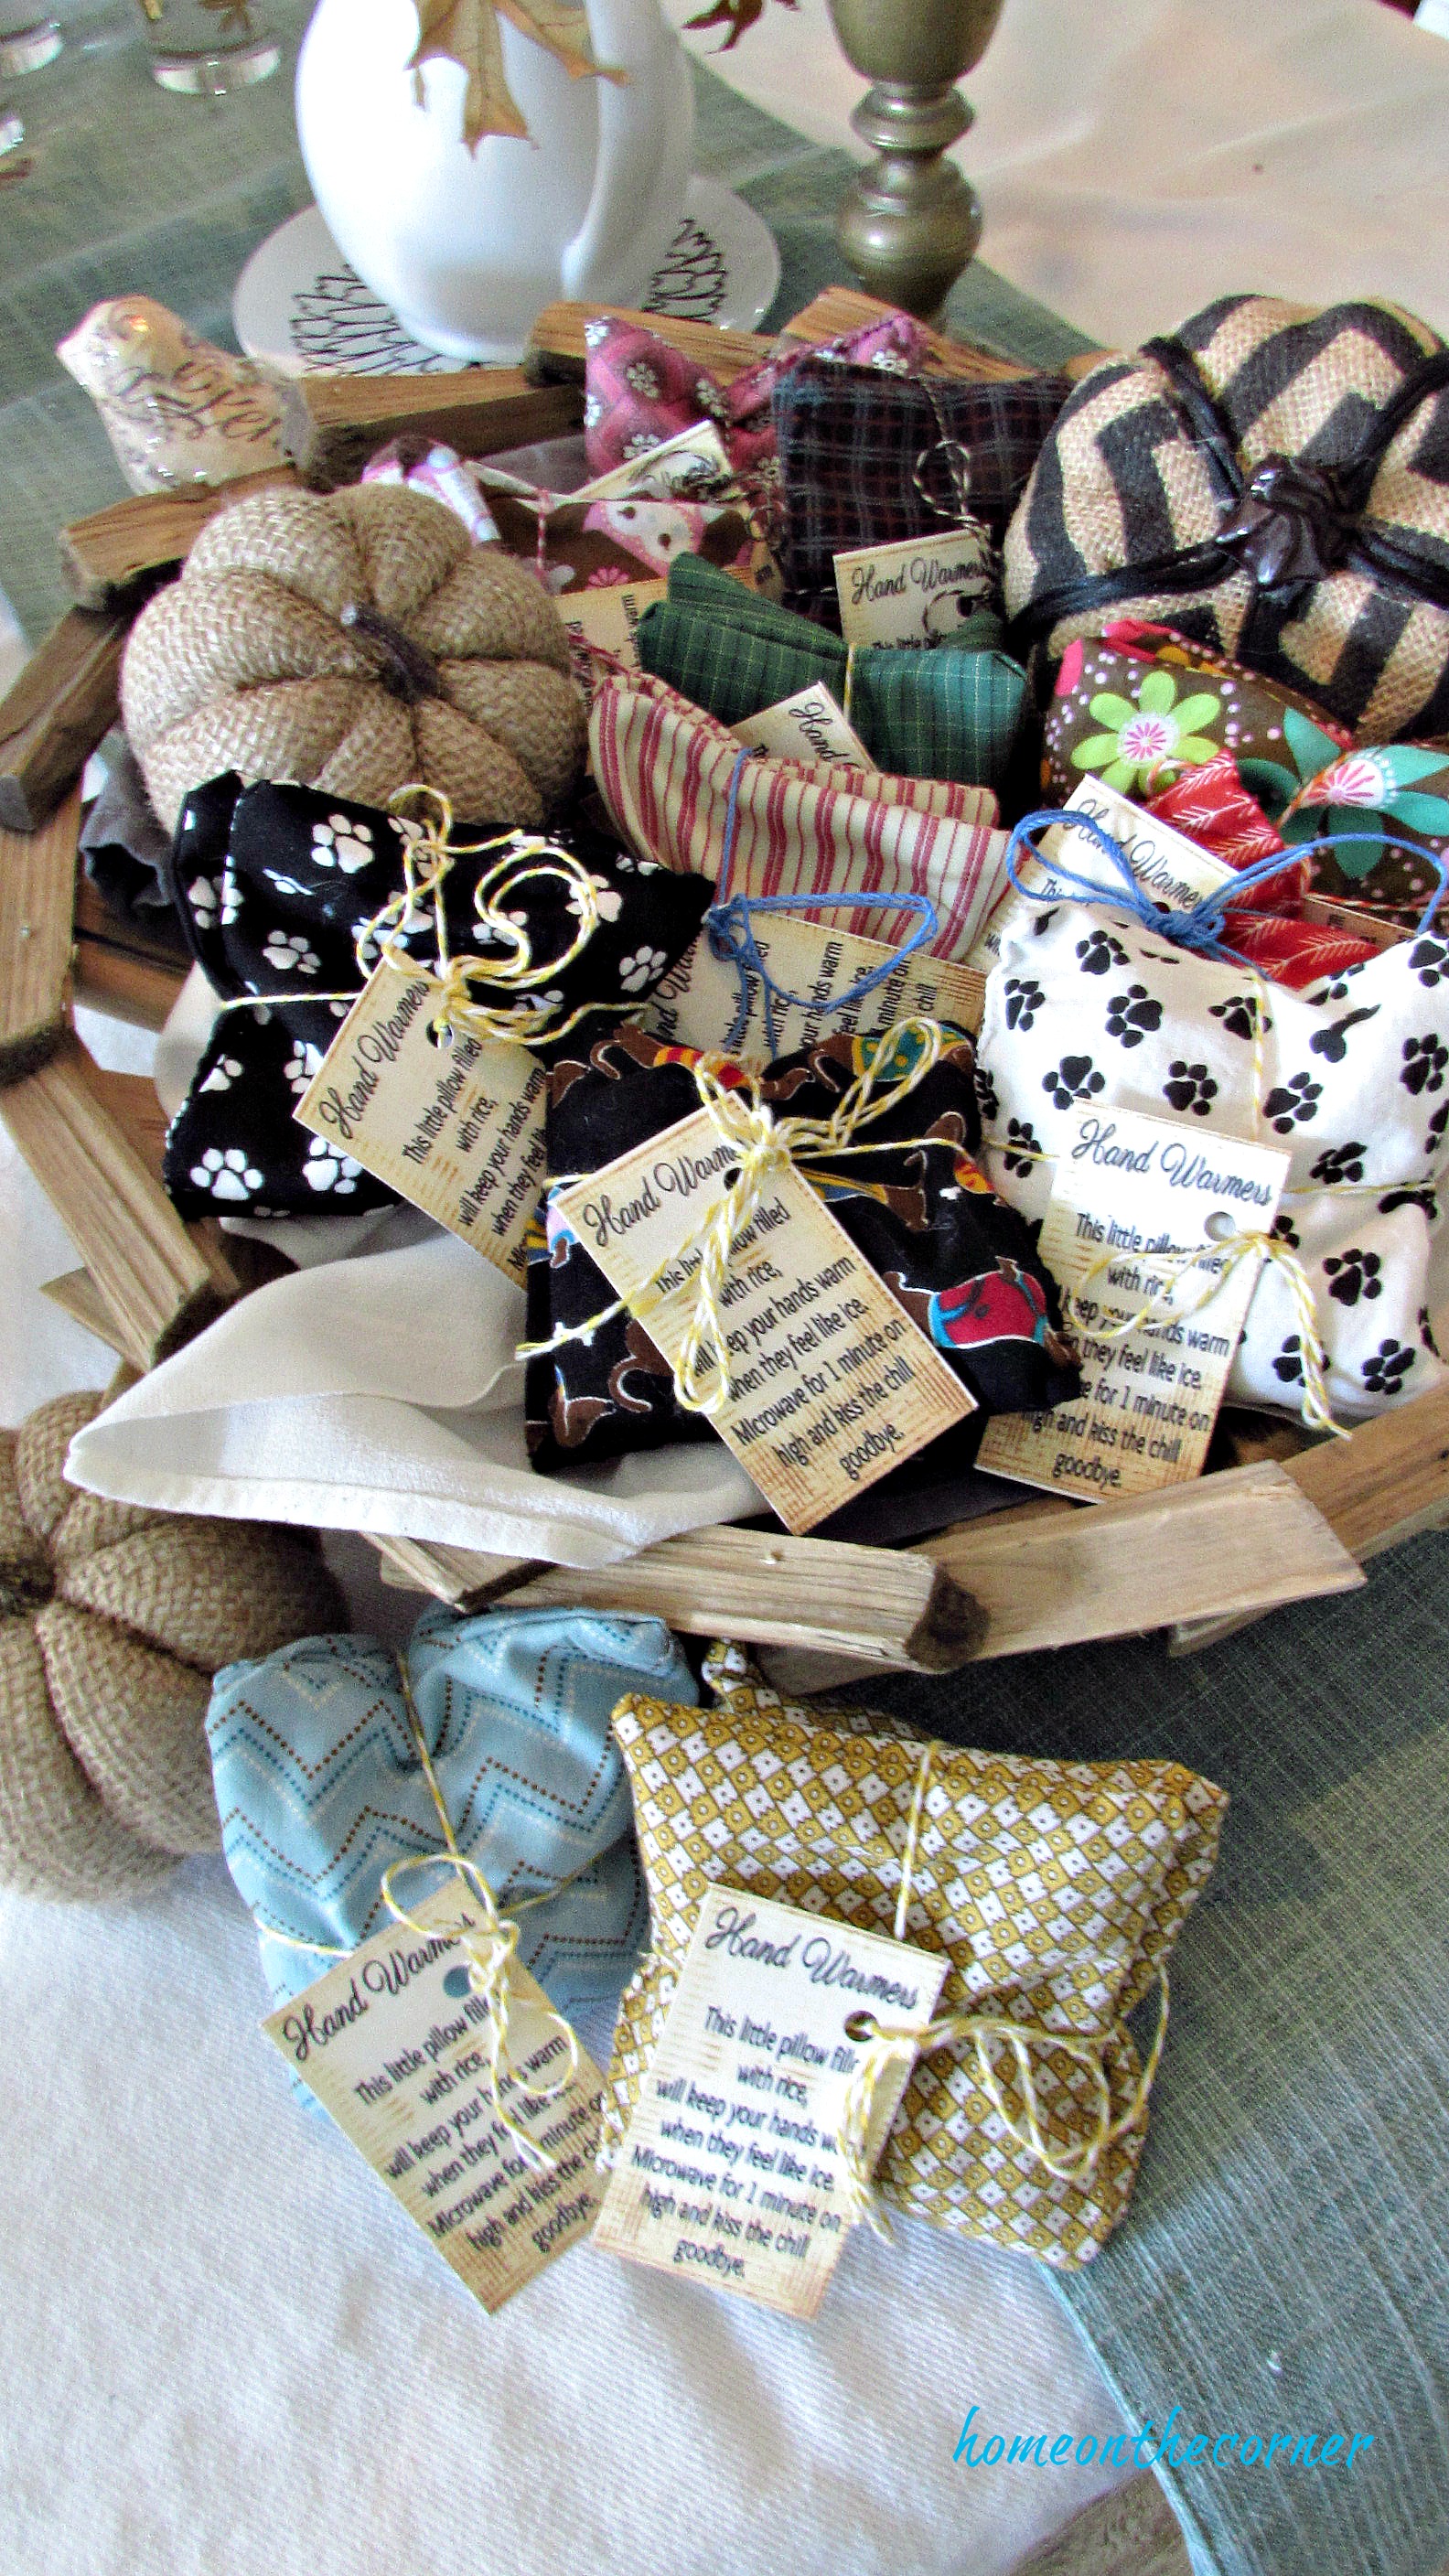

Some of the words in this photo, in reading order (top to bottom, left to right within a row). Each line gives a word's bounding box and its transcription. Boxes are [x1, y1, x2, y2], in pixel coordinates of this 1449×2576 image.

[851, 564, 907, 605] Hand
[909, 556, 984, 593] Warme
[789, 703, 850, 762] Hand
[1130, 840, 1204, 909] Warme
[800, 978, 832, 1021] hnds
[818, 939, 843, 980] warm
[875, 976, 905, 1026] minute
[910, 982, 938, 1012] chill
[319, 1055, 380, 1139] Hand
[358, 980, 430, 1063] Warmers
[520, 1067, 546, 1104] warm
[436, 1066, 467, 1114] pillow
[402, 1134, 432, 1165] This
[413, 1106, 447, 1140] little
[456, 1117, 479, 1153] with
[469, 1097, 499, 1125] rice,
[496, 1100, 531, 1143] hands
[486, 1136, 512, 1177] your
[506, 1167, 537, 1201] they
[520, 1139, 546, 1174] feel
[1071, 1118, 1160, 1173] Hand
[1160, 1143, 1272, 1207] Warmers
[458, 1195, 481, 1227] will
[464, 1168, 499, 1205] keep
[583, 1176, 662, 1247] Hand
[653, 1138, 752, 1197] Warm
[490, 1198, 520, 1237] when
[753, 1197, 791, 1233] filled
[1076, 1212, 1106, 1243] This
[1106, 1215, 1143, 1252] little
[718, 1272, 751, 1308] with
[747, 1260, 784, 1293] rice,
[744, 1308, 780, 1347] your
[769, 1278, 821, 1318] hands
[816, 1256, 858, 1291] warm
[1108, 1266, 1141, 1293] with
[728, 1366, 767, 1402] when
[759, 1346, 799, 1378] they
[788, 1316, 821, 1357] feel
[813, 1310, 847, 1339] like
[837, 1297, 870, 1322] ice.
[1118, 1342, 1149, 1376] feel
[1148, 1349, 1176, 1382] like
[1187, 1328, 1229, 1355] warm
[731, 1386, 810, 1446] Microwave
[800, 1372, 829, 1398] for
[823, 1360, 842, 1382] 1
[836, 1331, 889, 1374] minute
[884, 1317, 908, 1342] on
[1094, 1377, 1118, 1406] for
[1120, 1385, 1131, 1410] 1
[1132, 1392, 1187, 1427] minute
[1188, 1410, 1211, 1433] on
[771, 1432, 813, 1466] high
[806, 1410, 840, 1446] and
[827, 1397, 865, 1428] kiss
[857, 1380, 889, 1409] the
[883, 1354, 916, 1391] chill
[1056, 1411, 1088, 1437] and
[1087, 1413, 1118, 1447] kiss
[1120, 1424, 1146, 1455] the
[1148, 1433, 1183, 1464] chill
[839, 1422, 905, 1480] goodbye.
[704, 1905, 803, 1968] Hand
[801, 1936, 919, 2010] Warmers
[284, 1976, 370, 2062] Hand
[704, 2004, 738, 2039] This
[738, 2014, 778, 2052] little
[776, 2031, 830, 2064] pillow
[829, 2045, 860, 2074] fill
[353, 2073, 393, 2105] This
[382, 2046, 427, 2083] little
[422, 2015, 468, 2063] pillow
[463, 1991, 493, 2025] fill
[419, 2068, 458, 2105] with
[454, 2050, 492, 2081] rice,
[737, 2063, 774, 2092] with
[776, 2076, 809, 2109] rice,
[384, 2146, 417, 2179] will
[406, 2123, 454, 2161] keep
[448, 2098, 484, 2139] your
[524, 2034, 570, 2073] warm
[656, 2077, 686, 2103] will
[686, 2080, 727, 2123] keep
[724, 2103, 767, 2130] your
[767, 2108, 820, 2147] hands
[422, 2160, 466, 2197] when
[459, 2132, 499, 2167] they
[660, 2116, 704, 2149] when
[706, 2128, 745, 2166] they
[746, 2140, 779, 2173] feel
[778, 2150, 808, 2183] like
[426, 2171, 510, 2238] Microwave
[465, 2212, 505, 2251] high
[503, 2191, 535, 2227] and
[524, 2173, 563, 2205] kiss
[555, 2152, 586, 2181] the
[630, 2142, 718, 2192] Microwave
[719, 2171, 745, 2199] for
[746, 2180, 757, 2205] 1
[758, 2190, 818, 2226] minute
[819, 2209, 843, 2233] on
[639, 2180, 677, 2221] high
[677, 2201, 714, 2227] and
[711, 2205, 744, 2238] kiss
[745, 2217, 773, 2249] the
[775, 2227, 811, 2259] chill
